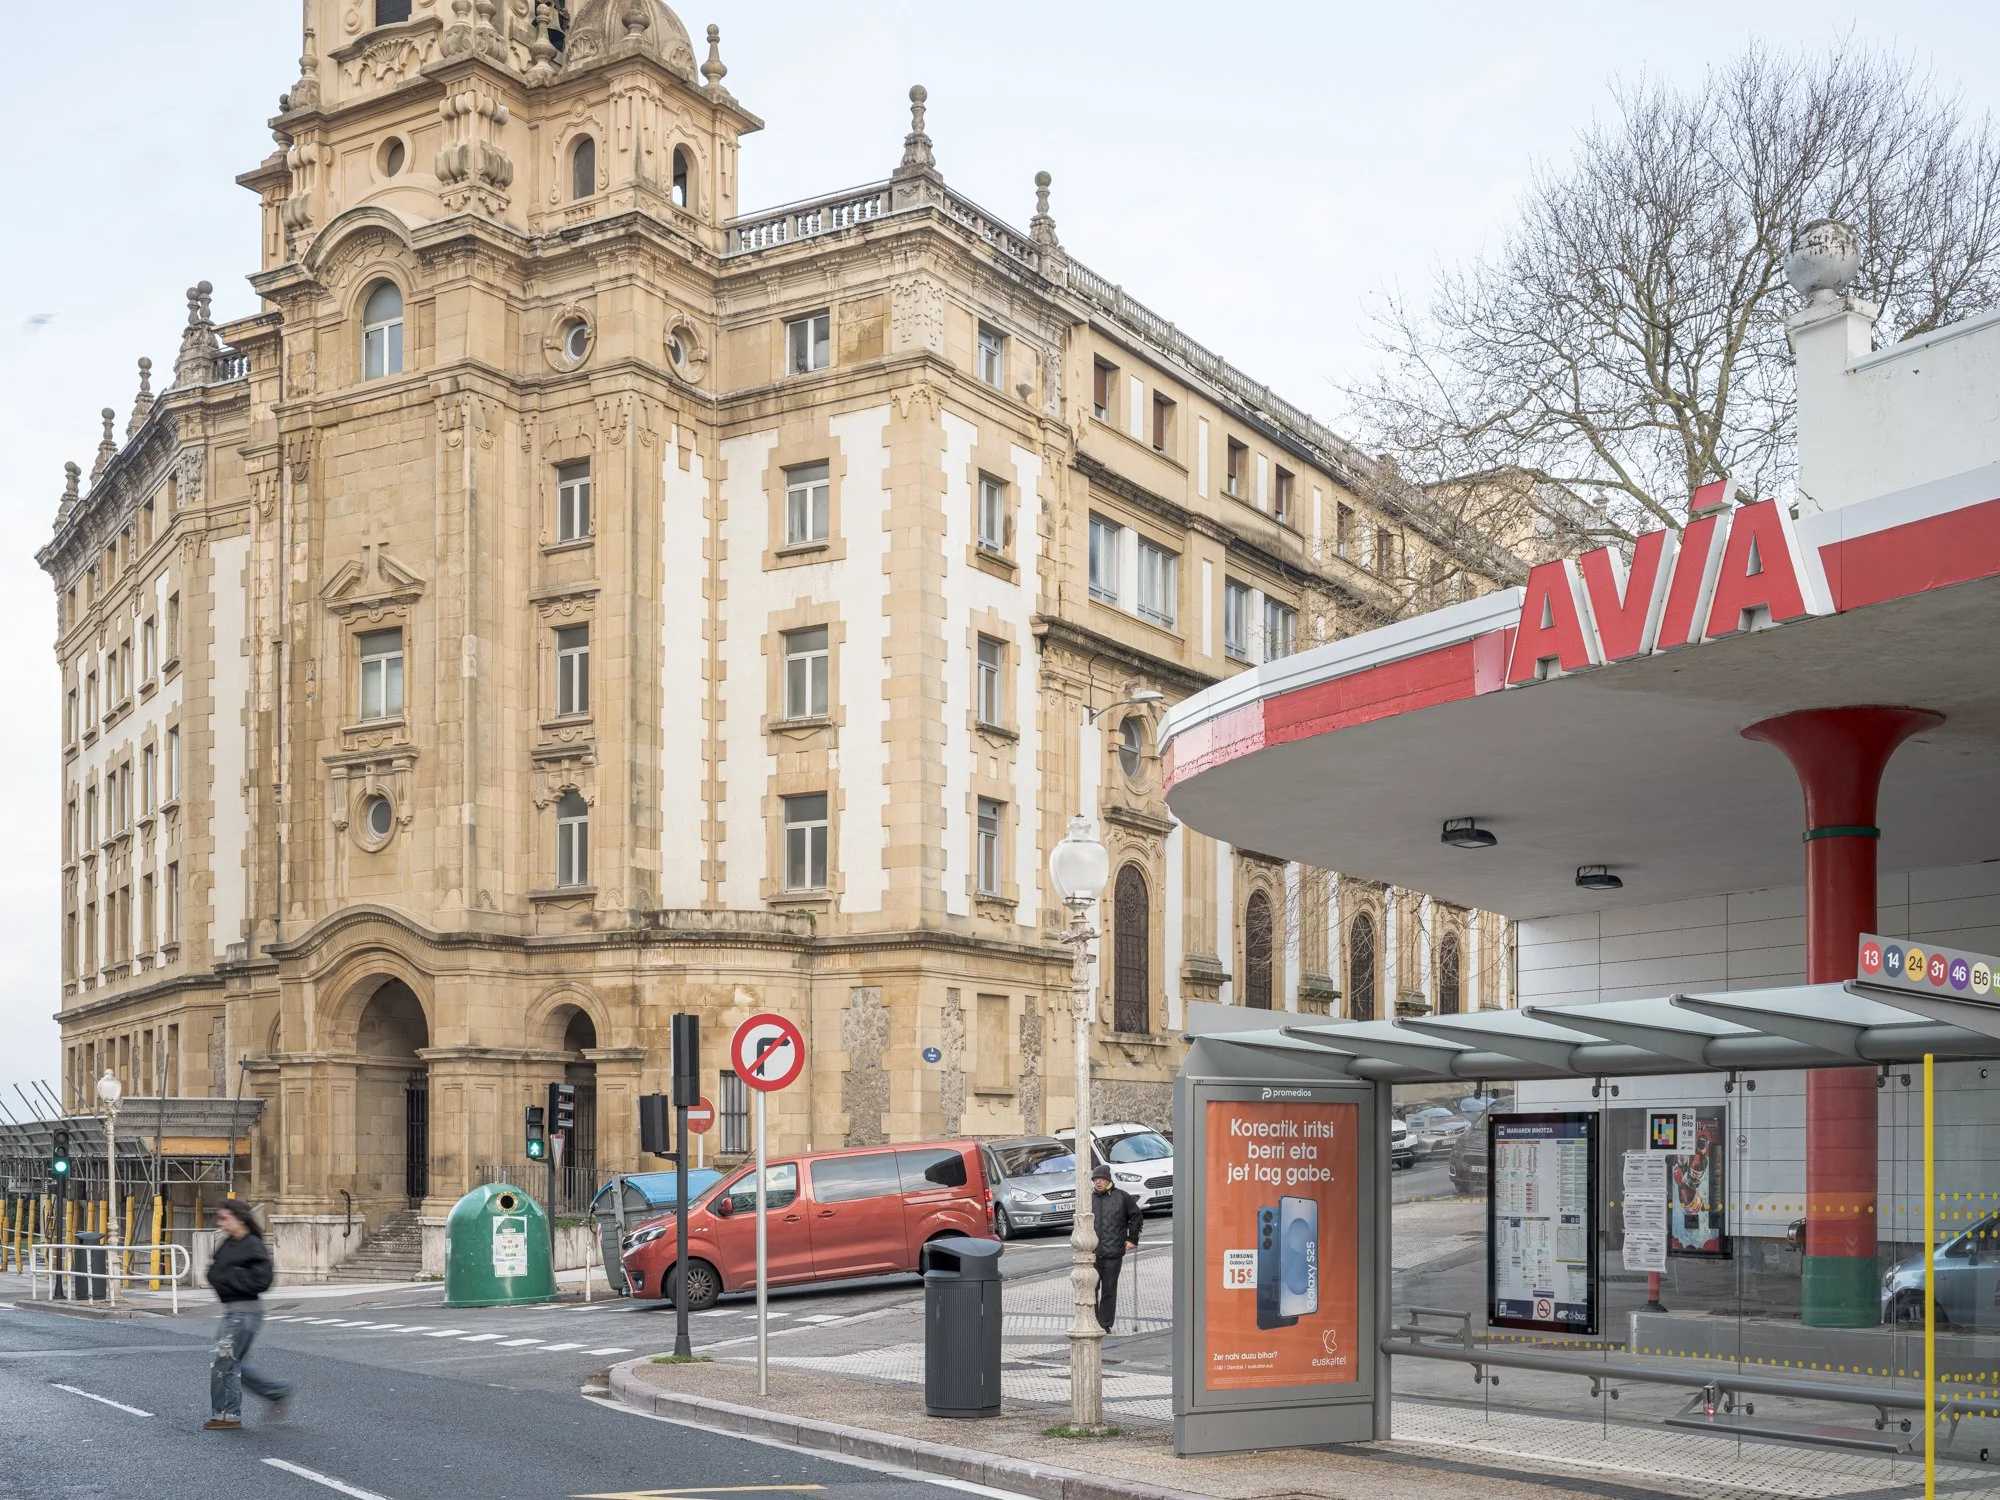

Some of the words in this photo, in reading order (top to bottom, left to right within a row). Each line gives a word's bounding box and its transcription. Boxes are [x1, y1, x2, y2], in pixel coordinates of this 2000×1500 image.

[1506, 478, 1838, 690] AVIA
[1864, 950, 1879, 966] 13
[1887, 953, 1900, 969] 14
[1908, 956, 1923, 971] 24
[1931, 961, 1944, 979] 31
[1952, 966, 1967, 982] 46
[1973, 970, 1989, 986] B6
[1273, 1089, 1312, 1098] promedios
[1231, 1118, 1298, 1138] Koreatik
[1303, 1121, 1334, 1138] iritsi
[1248, 1141, 1285, 1160] berri
[1290, 1142, 1317, 1160] eta
[1227, 1163, 1250, 1185] jet
[1255, 1163, 1282, 1185] lag
[1286, 1164, 1335, 1186] gabe.
[1306, 1241, 1316, 1261] S25
[1306, 1265, 1316, 1310] Galaxy
[1312, 1356, 1346, 1366] euskaltel
